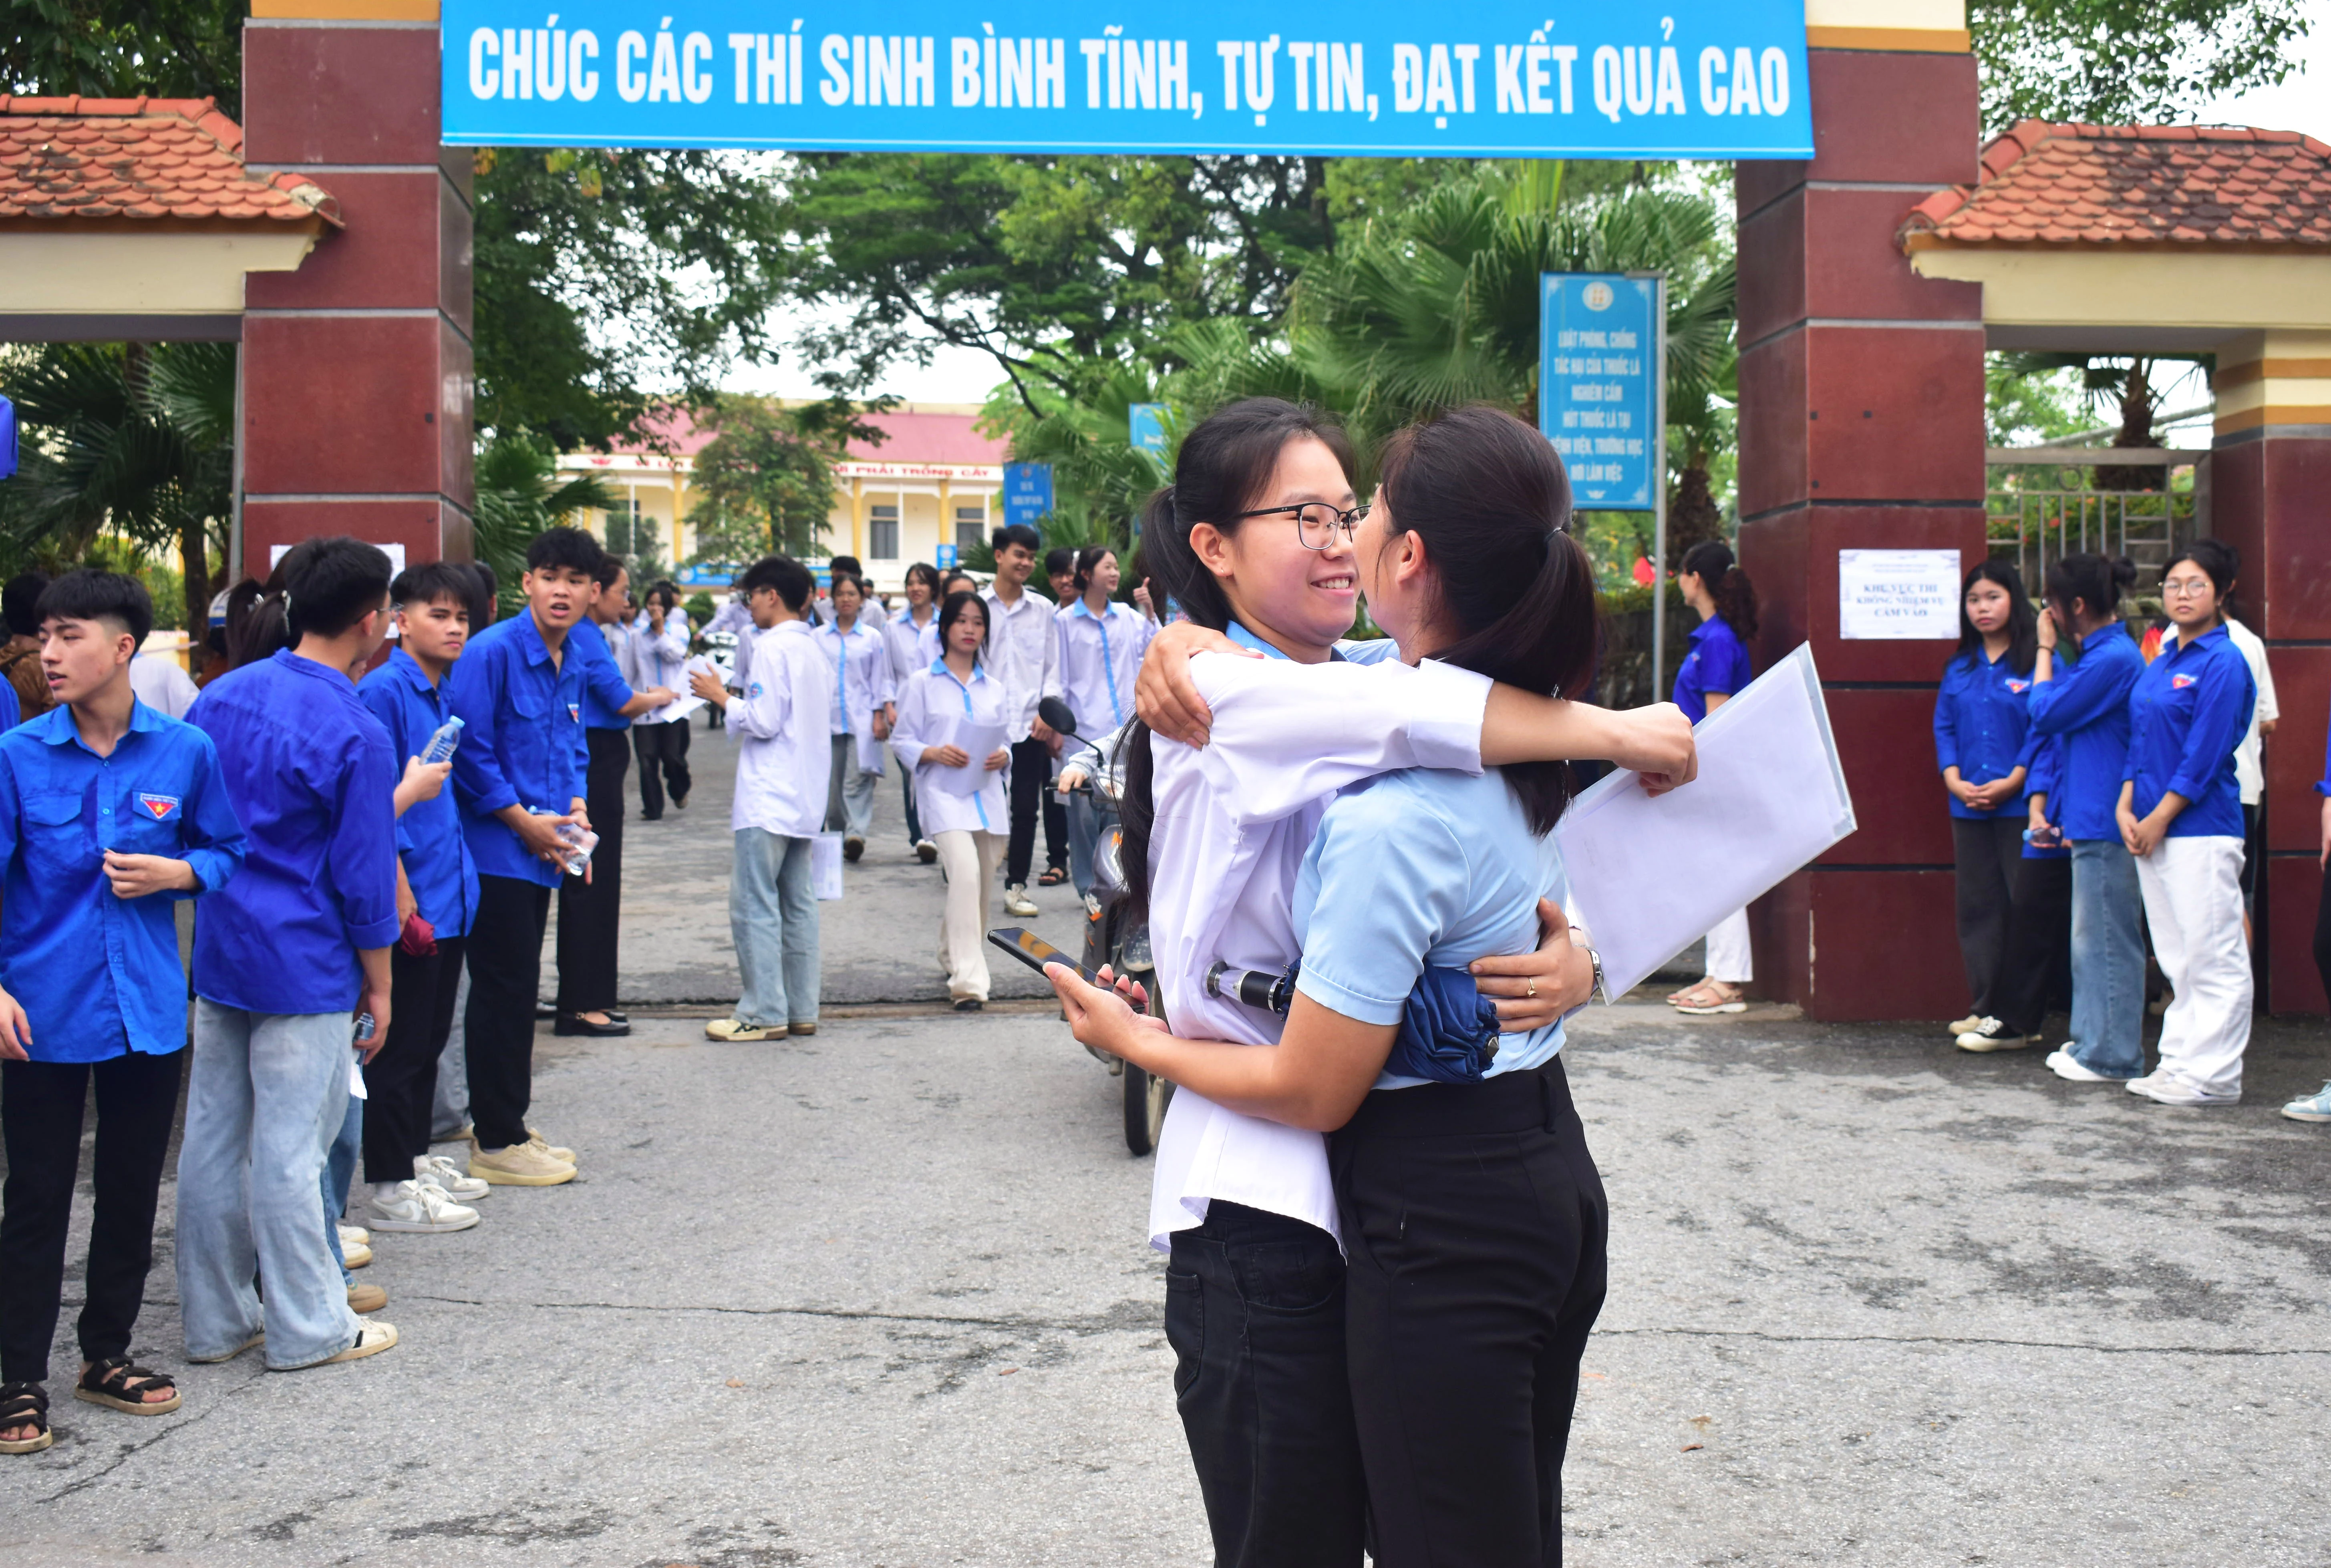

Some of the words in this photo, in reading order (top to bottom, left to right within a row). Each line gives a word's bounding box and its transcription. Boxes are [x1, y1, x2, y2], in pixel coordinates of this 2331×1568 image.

[469, 14, 598, 101] CHÚC
[617, 16, 713, 103] CÁC
[729, 19, 803, 104] THÍ
[820, 35, 934, 106] SINH
[951, 22, 1065, 109] BÌNH
[1080, 25, 1202, 119] TĨNH,
[1217, 34, 1280, 126] TỰ
[1288, 42, 1379, 121] TIN,
[1392, 44, 1480, 129] ĐẠT
[1495, 20, 1577, 115] KẾT
[1593, 17, 1686, 122] QUẢ
[1699, 47, 1789, 116] CAO
[856, 463, 894, 474] PHẢI
